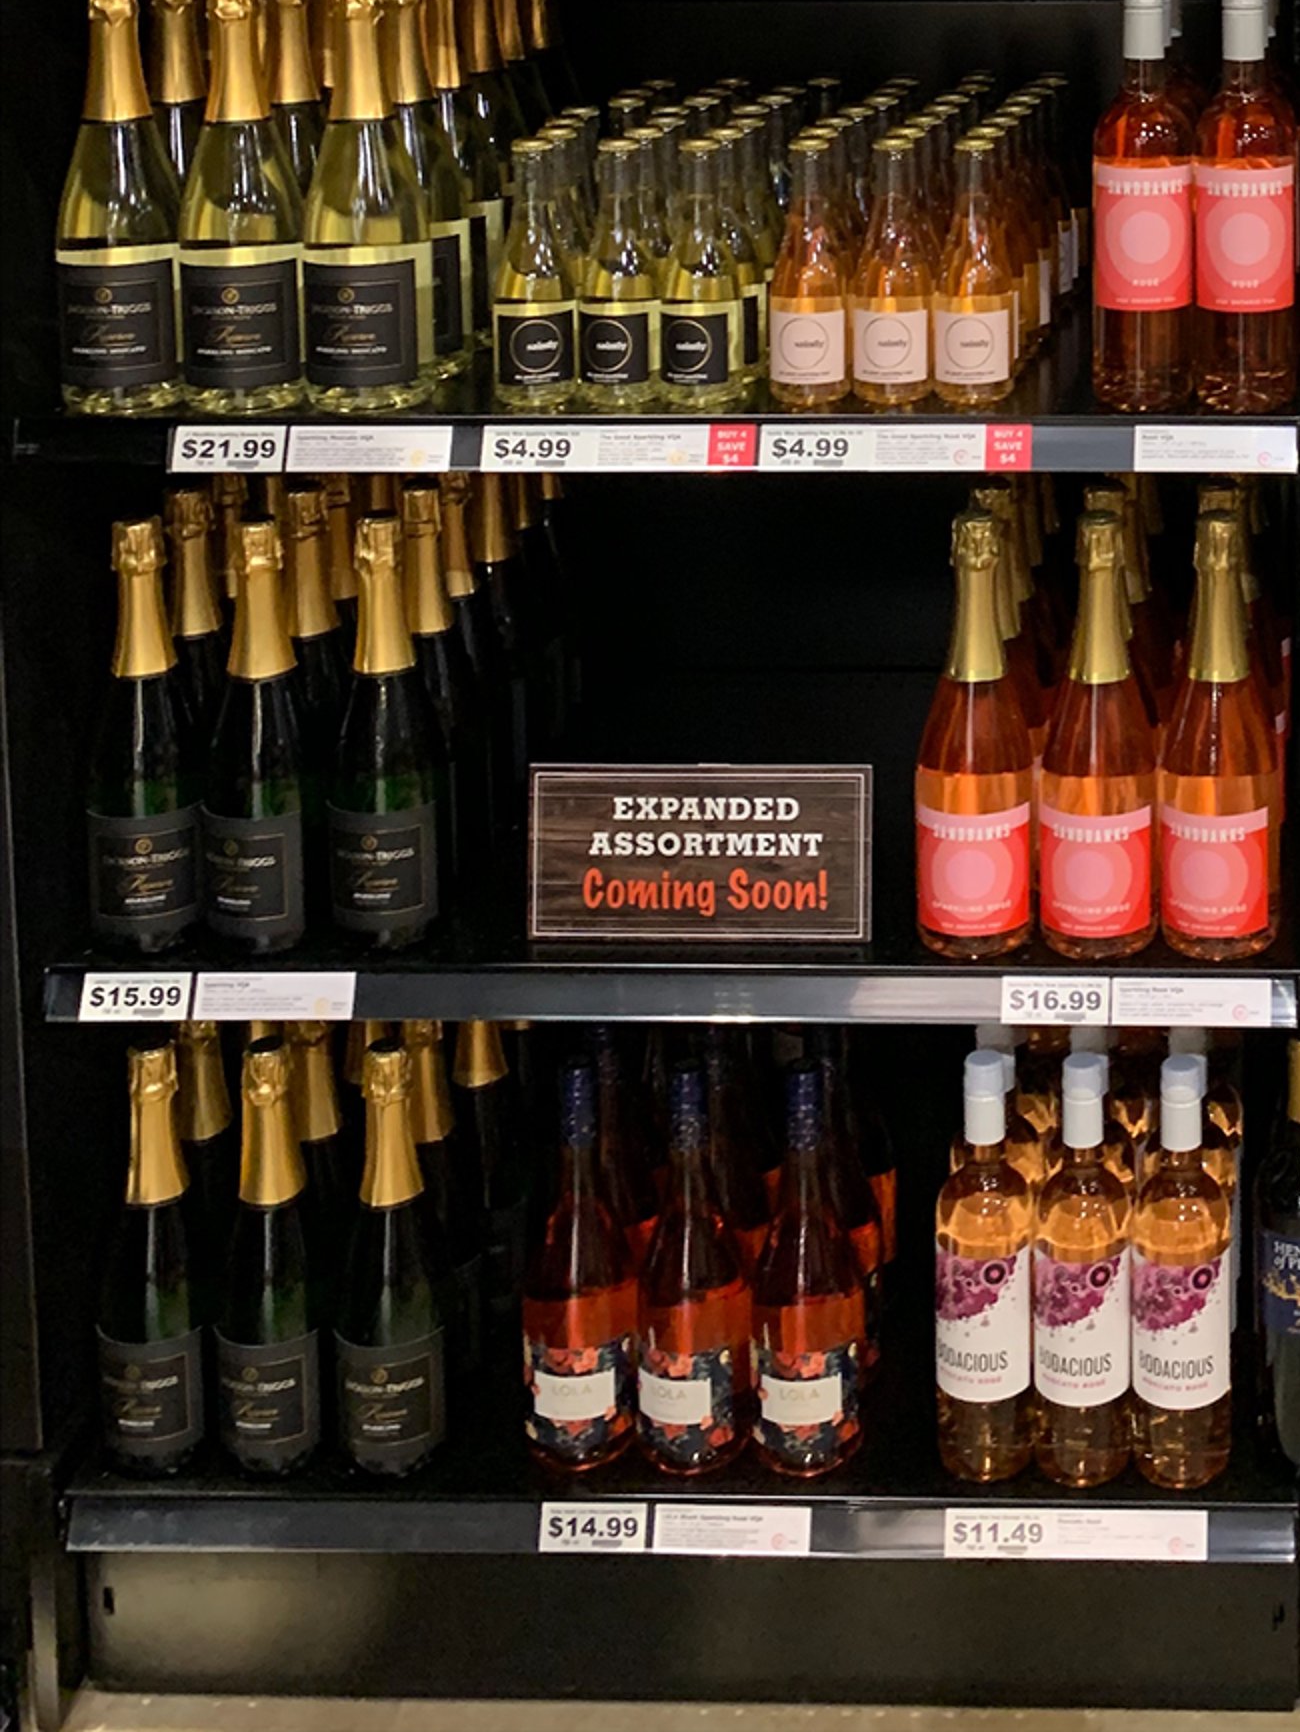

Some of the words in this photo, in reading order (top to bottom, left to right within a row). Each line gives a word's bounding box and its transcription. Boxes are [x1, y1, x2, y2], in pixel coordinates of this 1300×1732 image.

[526, 339, 559, 351] saintly
[596, 341, 627, 352] saintly
[675, 341, 707, 353] saintly
[181, 438, 276, 460] $21.99
[494, 438, 571, 459] $4.99
[717, 441, 745, 451] SAVE
[772, 437, 849, 457] $4.99
[993, 441, 1022, 451] SAVE
[722, 453, 739, 465] $4
[999, 453, 1016, 465] $4
[612, 797, 800, 821] EXPANDED
[589, 831, 823, 857] ASSORTMENT
[583, 867, 716, 917] Coming
[727, 868, 828, 911] Soon!
[90, 987, 181, 1007] $15.99
[1009, 990, 1101, 1011] $16.99
[1274, 1255, 1285, 1270] of
[1039, 1352, 1112, 1375] BODACIOUS
[1139, 1349, 1214, 1378] BODACIOUS
[551, 1382, 592, 1398] LOLA
[652, 1385, 687, 1400] LOLA
[779, 1386, 820, 1400] LOLA
[548, 1516, 638, 1538] $14.99
[953, 1522, 1042, 1543] $11.49
